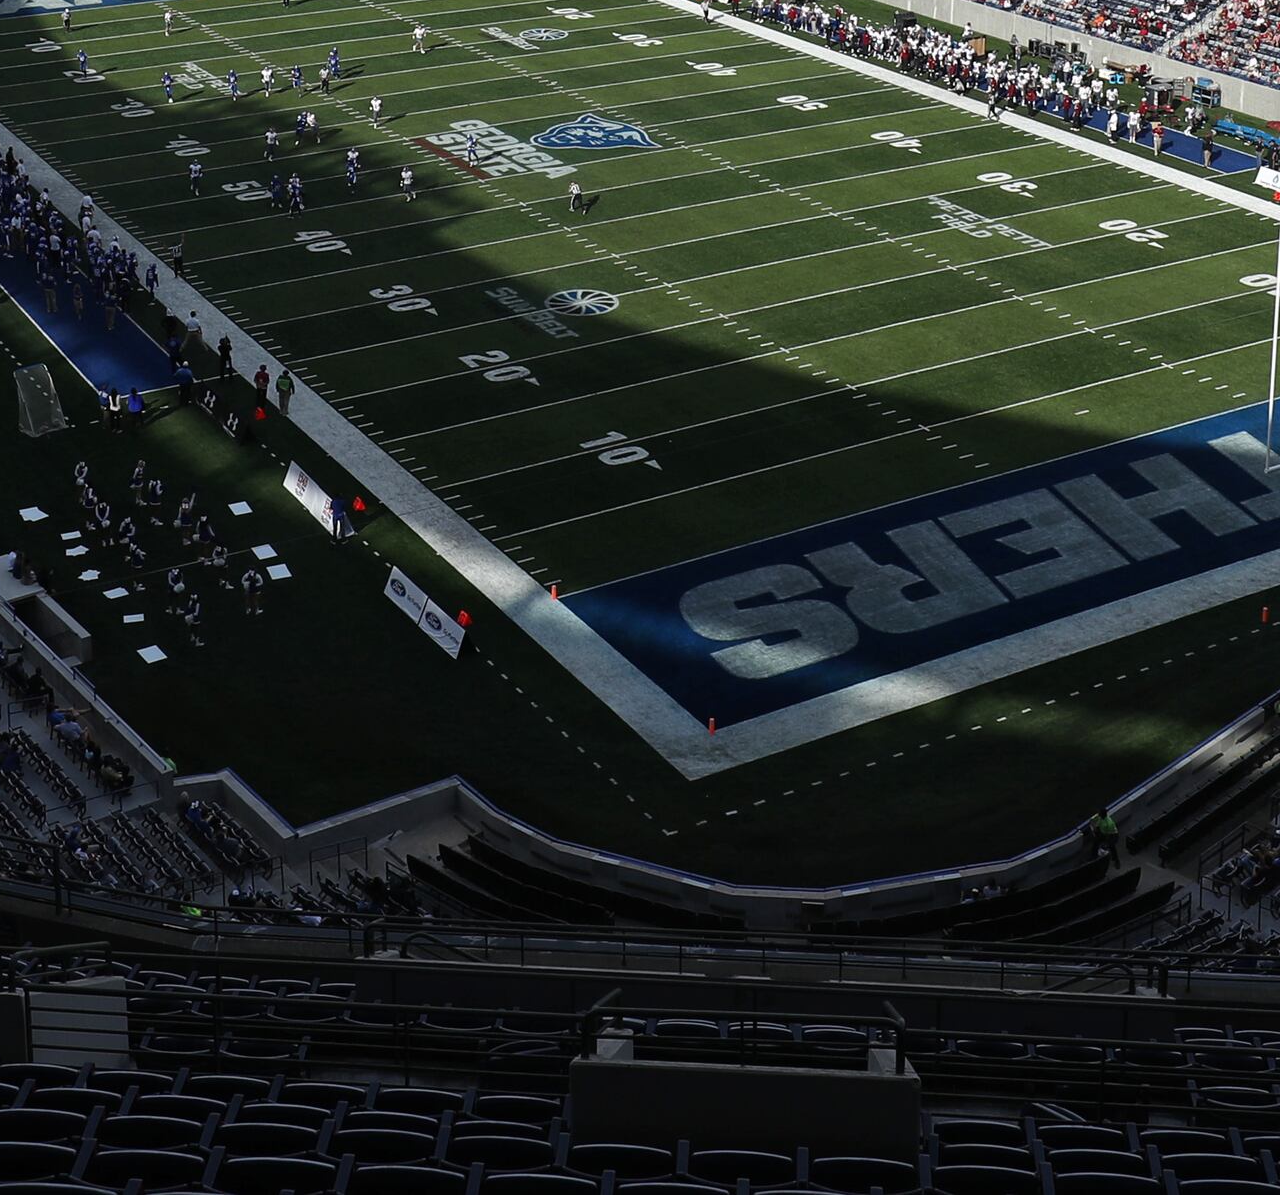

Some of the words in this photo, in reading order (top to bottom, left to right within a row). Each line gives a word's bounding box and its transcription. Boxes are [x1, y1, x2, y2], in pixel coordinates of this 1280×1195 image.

[549, 7, 596, 21] 20
[25, 40, 62, 53] 10
[618, 33, 664, 48] 30
[62, 68, 106, 84] 20
[692, 62, 738, 77] 40
[110, 100, 156, 118] 30
[776, 95, 828, 112] 50
[165, 138, 212, 158] 40
[450, 120, 578, 180] GEORGIA
[870, 130, 922, 151] 40
[221, 180, 274, 203] 50
[976, 172, 1038, 193] 30
[930, 214, 992, 238] FIELD
[986, 223, 1053, 248] PETIT
[1098, 219, 1170, 243] 20
[293, 230, 347, 254] 40
[368, 284, 432, 315] 30
[484, 286, 537, 314] SUN
[524, 310, 580, 338] BELT
[458, 350, 532, 384] 20
[579, 431, 650, 466] 10
